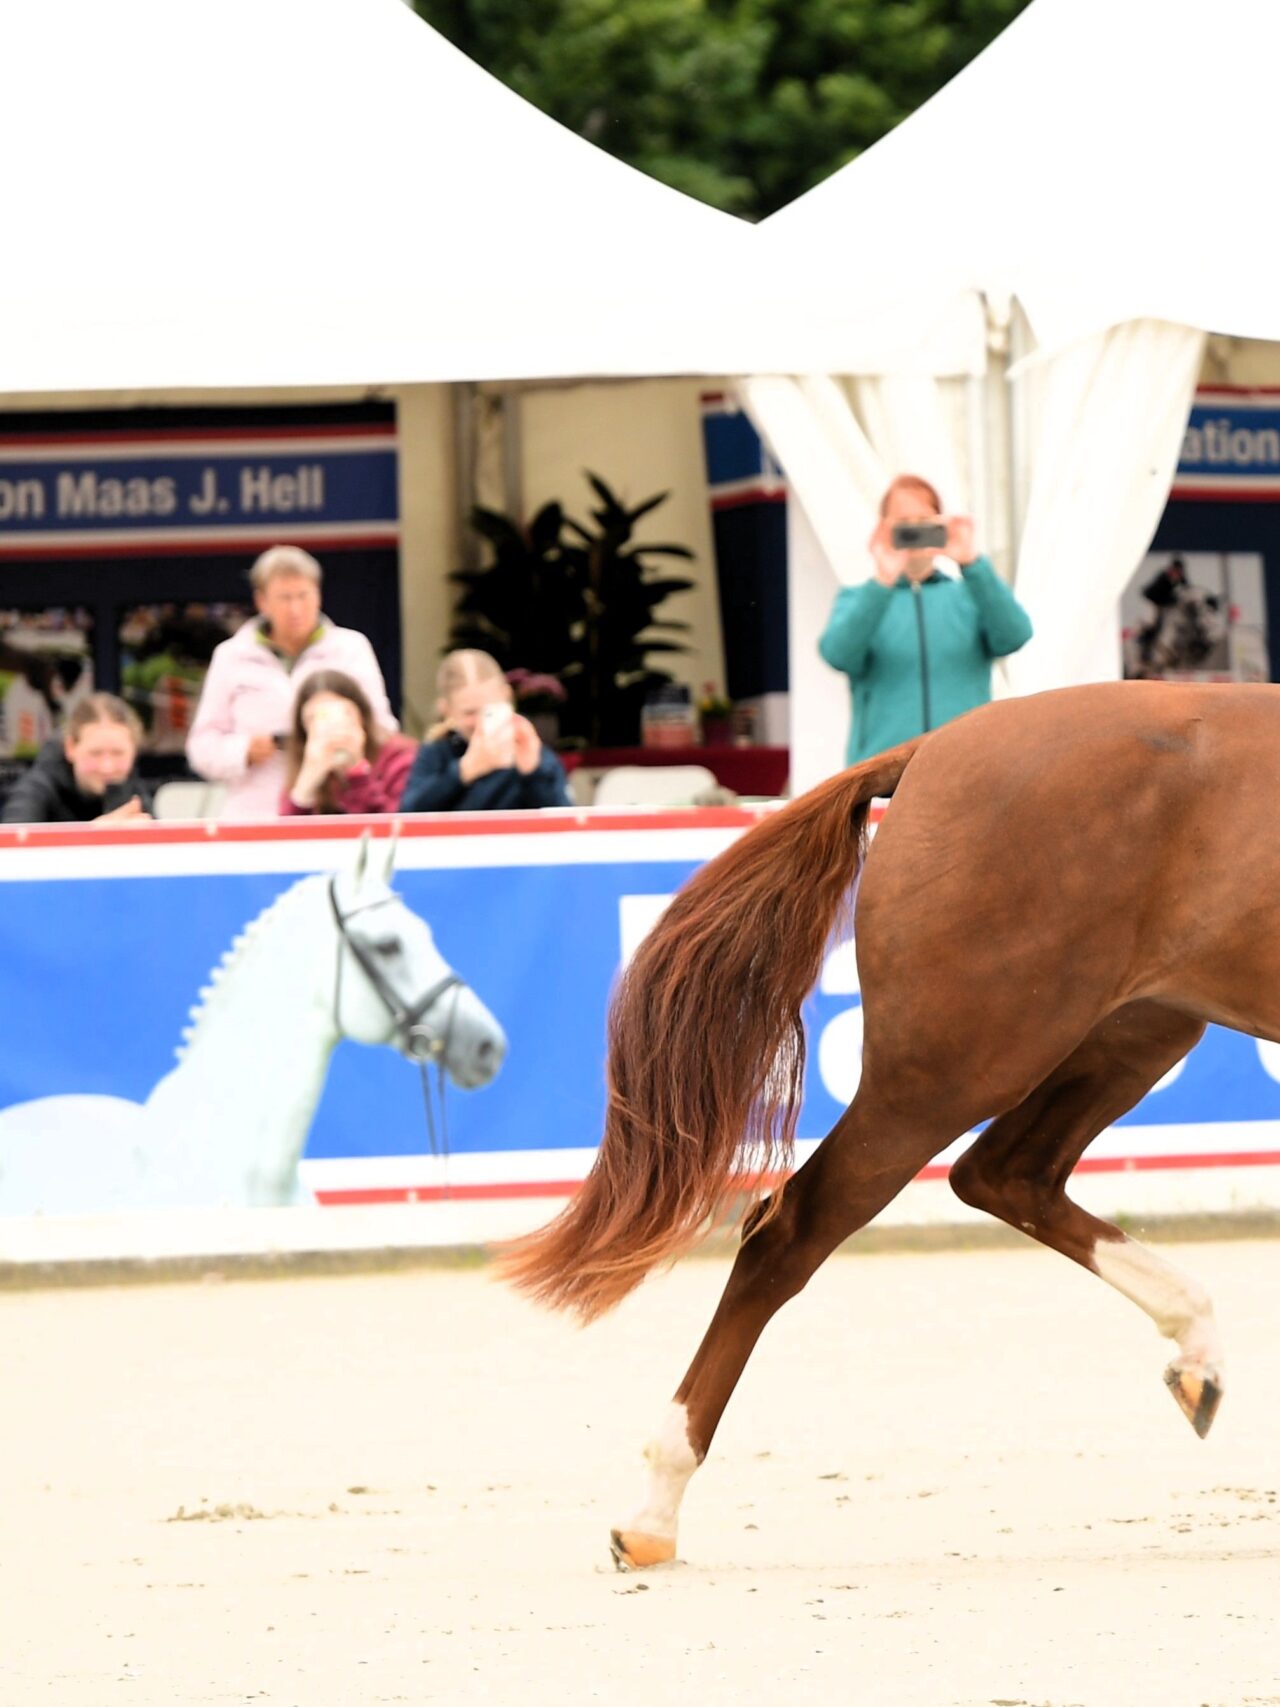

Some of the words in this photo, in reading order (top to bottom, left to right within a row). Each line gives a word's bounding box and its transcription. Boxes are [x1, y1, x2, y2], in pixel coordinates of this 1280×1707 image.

[57, 471, 176, 518] Maas
[190, 467, 229, 514] J.
[240, 464, 325, 513] Hell
